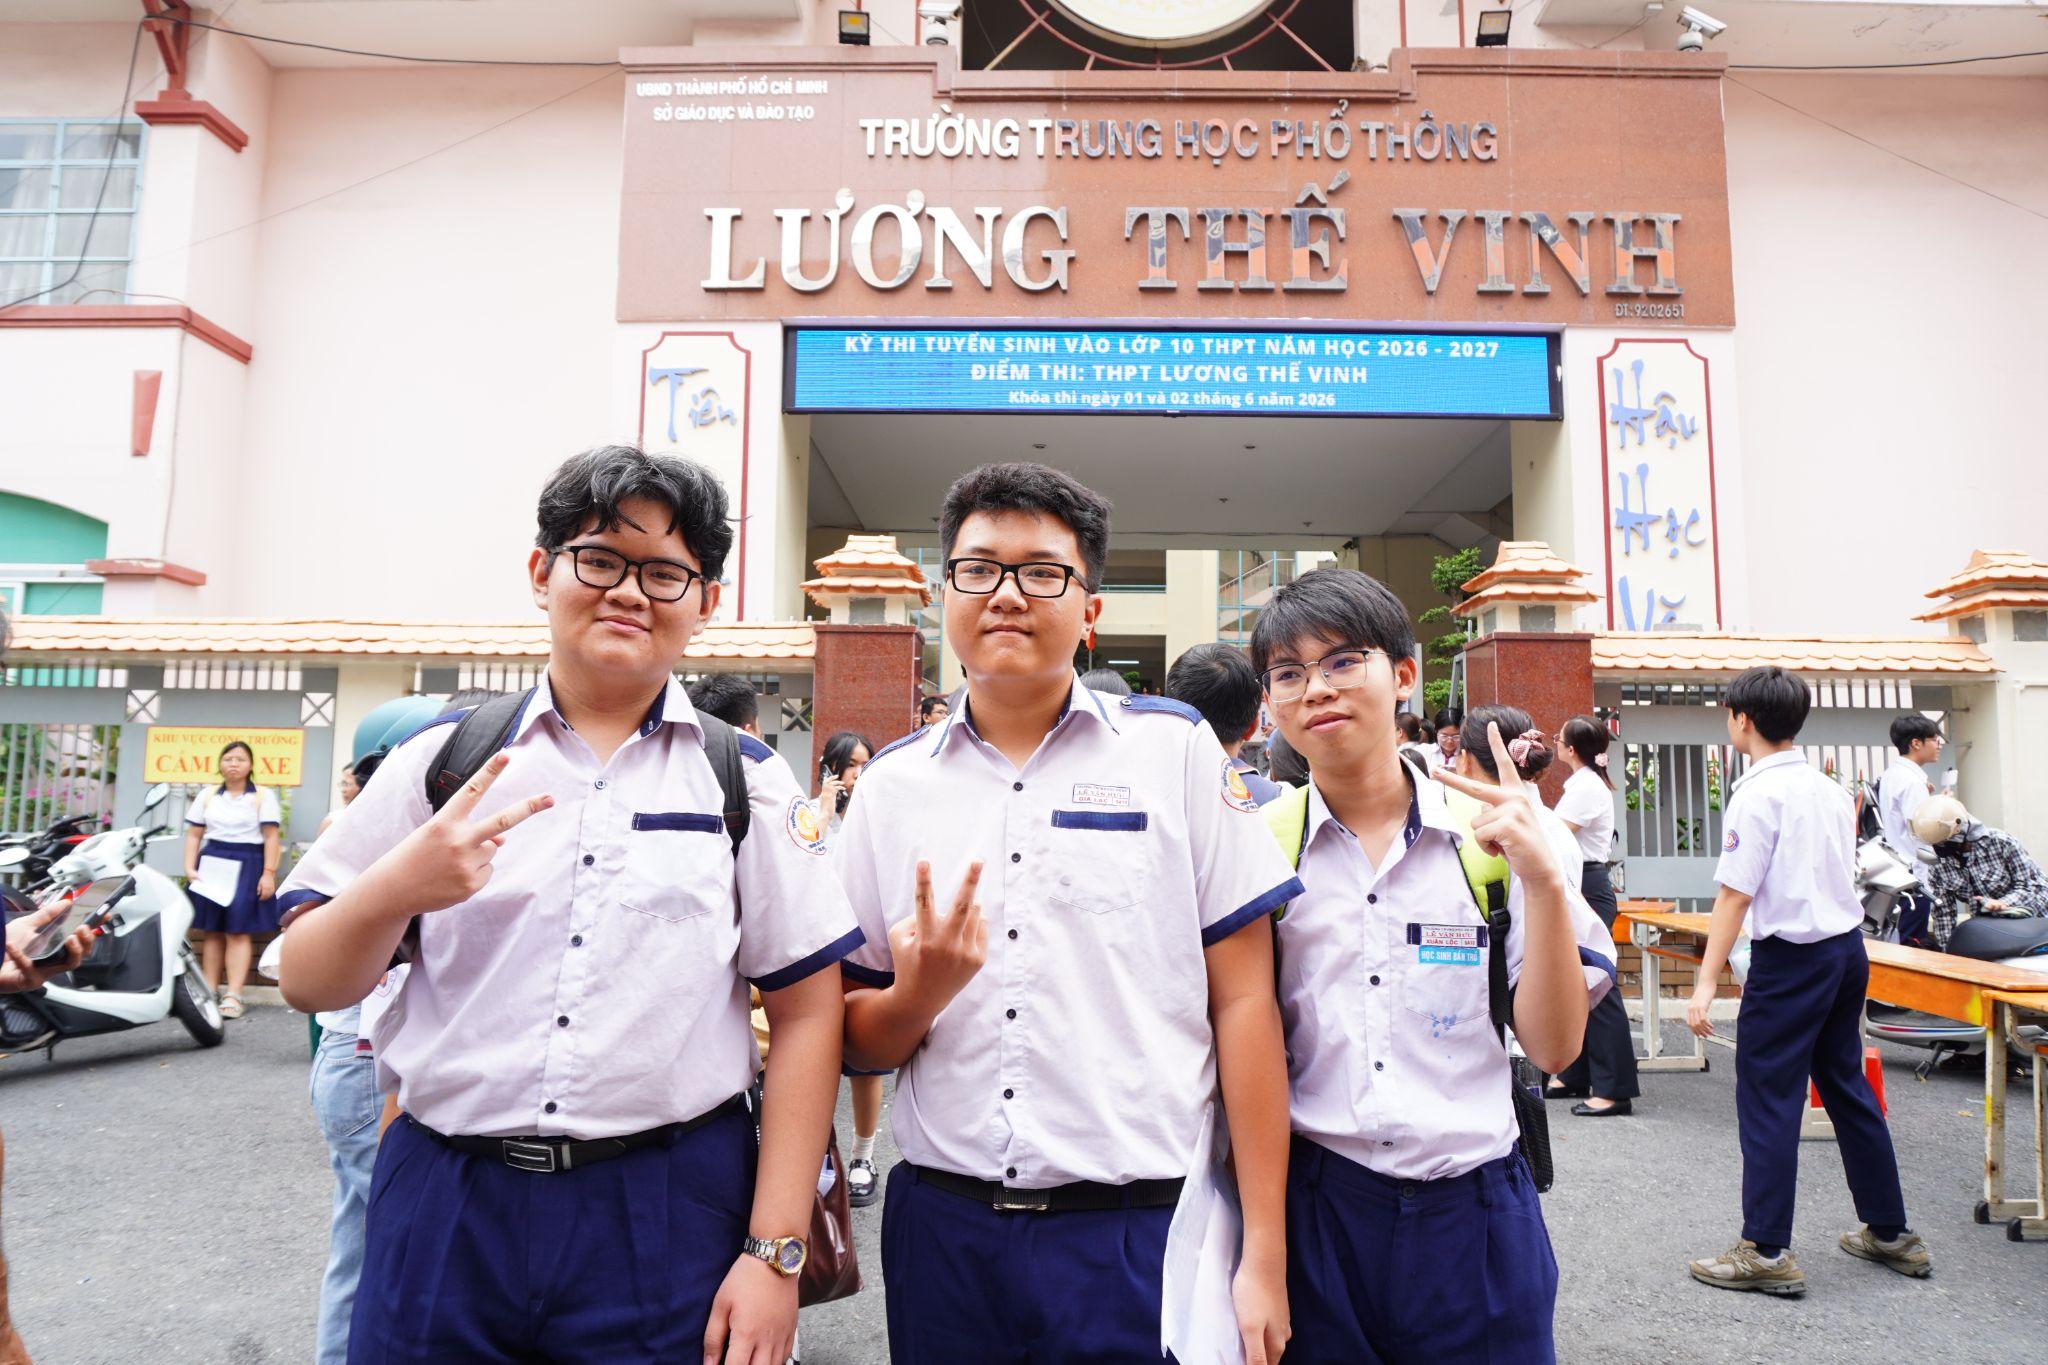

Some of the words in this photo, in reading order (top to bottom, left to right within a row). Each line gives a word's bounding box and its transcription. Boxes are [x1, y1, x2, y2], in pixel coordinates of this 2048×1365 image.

[636, 82, 672, 96] UBND
[675, 78, 718, 96] THÀNH
[720, 76, 747, 95] PHỐ
[749, 75, 768, 94] HỒ
[770, 78, 792, 94] CHÍ
[796, 80, 828, 94] MINH
[653, 103, 672, 121] SỞ
[675, 104, 704, 120] GIÁO
[708, 106, 735, 123] DỤC
[737, 103, 754, 119] VÀ
[756, 104, 784, 120] ĐÀO
[787, 106, 814, 122] TẠO
[859, 104, 1020, 160] TRƯỜNG
[1028, 118, 1162, 159] TRUNG
[1175, 118, 1259, 166] HỌC
[1270, 99, 1351, 160] PHỔ
[1360, 109, 1499, 161] THÔNG
[701, 188, 1076, 292] LƯƠNG
[1125, 170, 1351, 294] THẾ
[1392, 207, 1684, 297] VINH
[845, 334, 873, 353] KỲ
[880, 337, 915, 353] THI
[924, 331, 996, 353] TUYỂN
[1003, 337, 1056, 353] SINH
[1065, 334, 1111, 354] VÀO
[1119, 334, 1161, 354] LỚP
[1171, 338, 1194, 354] 10
[1202, 338, 1256, 355] THPT
[1265, 335, 1316, 356] NĂM
[1325, 339, 1371, 359] HỌC
[1378, 340, 1428, 357] 2026
[1449, 341, 1499, 358] 2027
[971, 357, 1030, 381] ĐIỂM
[1039, 364, 1085, 381] THI:
[1093, 364, 1152, 382] THPT
[1160, 364, 1248, 382] LƯƠNG
[1256, 360, 1302, 383] THẾ
[1307, 366, 1368, 384] VINH
[649, 366, 737, 443] Tiên
[1009, 389, 1050, 405] Khóa
[1054, 390, 1077, 405] thi
[1081, 390, 1121, 408] ngày
[1124, 391, 1143, 405] 01
[1147, 391, 1166, 405] và
[1170, 391, 1189, 405] 02
[1193, 391, 1242, 408] tháng
[1245, 392, 1254, 406] 6
[1258, 391, 1294, 406] năm
[1298, 392, 1336, 407] 2026
[1610, 359, 1699, 450] Hậu
[1615, 463, 1706, 558] Học
[153, 733, 177, 744] KHU
[182, 733, 206, 745] VỰC
[260, 757, 291, 775] XE
[1421, 950, 1435, 961] HỌC
[1437, 951, 1452, 961] SINH
